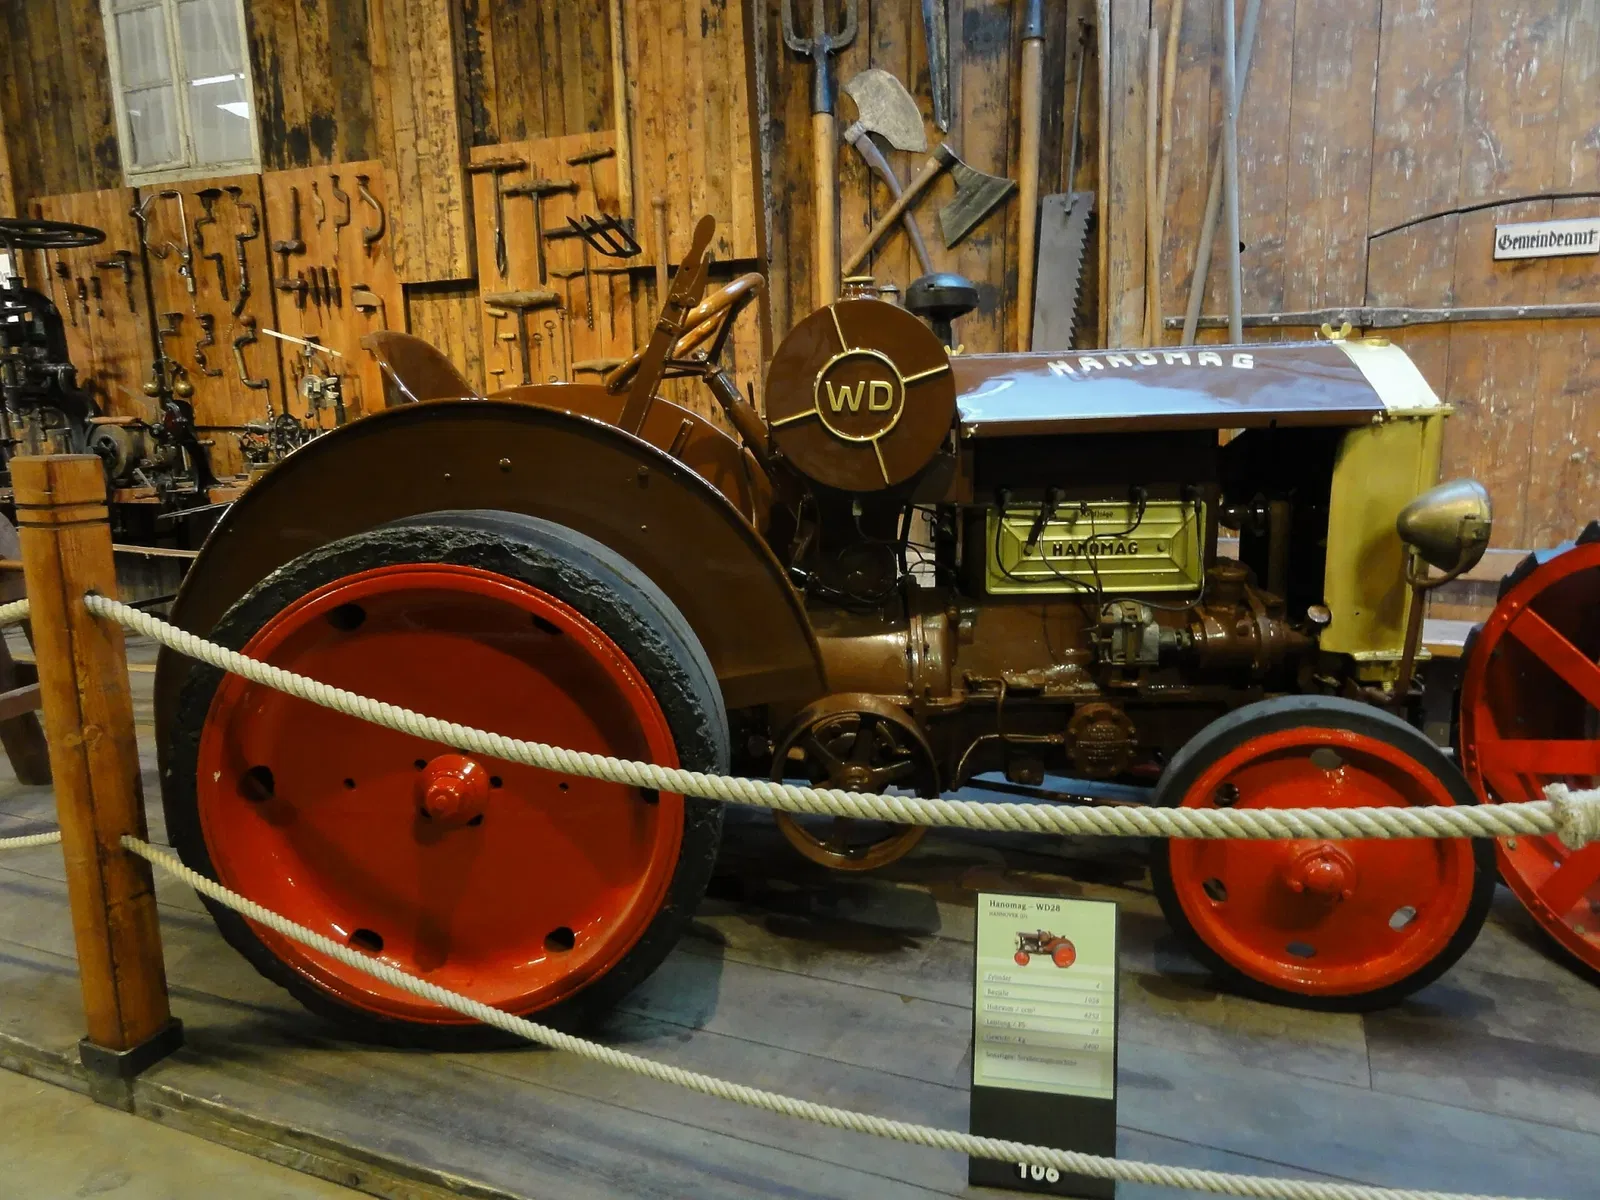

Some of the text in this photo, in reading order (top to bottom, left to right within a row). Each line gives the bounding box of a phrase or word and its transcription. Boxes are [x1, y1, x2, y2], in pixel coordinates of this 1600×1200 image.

[1497, 228, 1598, 250] Gemeindeamt
[1047, 351, 1254, 376] HANOMAG
[825, 380, 893, 412] WD
[1052, 540, 1139, 557] HANOMAG
[989, 899, 1027, 911] Hanomag
[1035, 902, 1061, 912] WD28
[1018, 1162, 1060, 1183] 106
